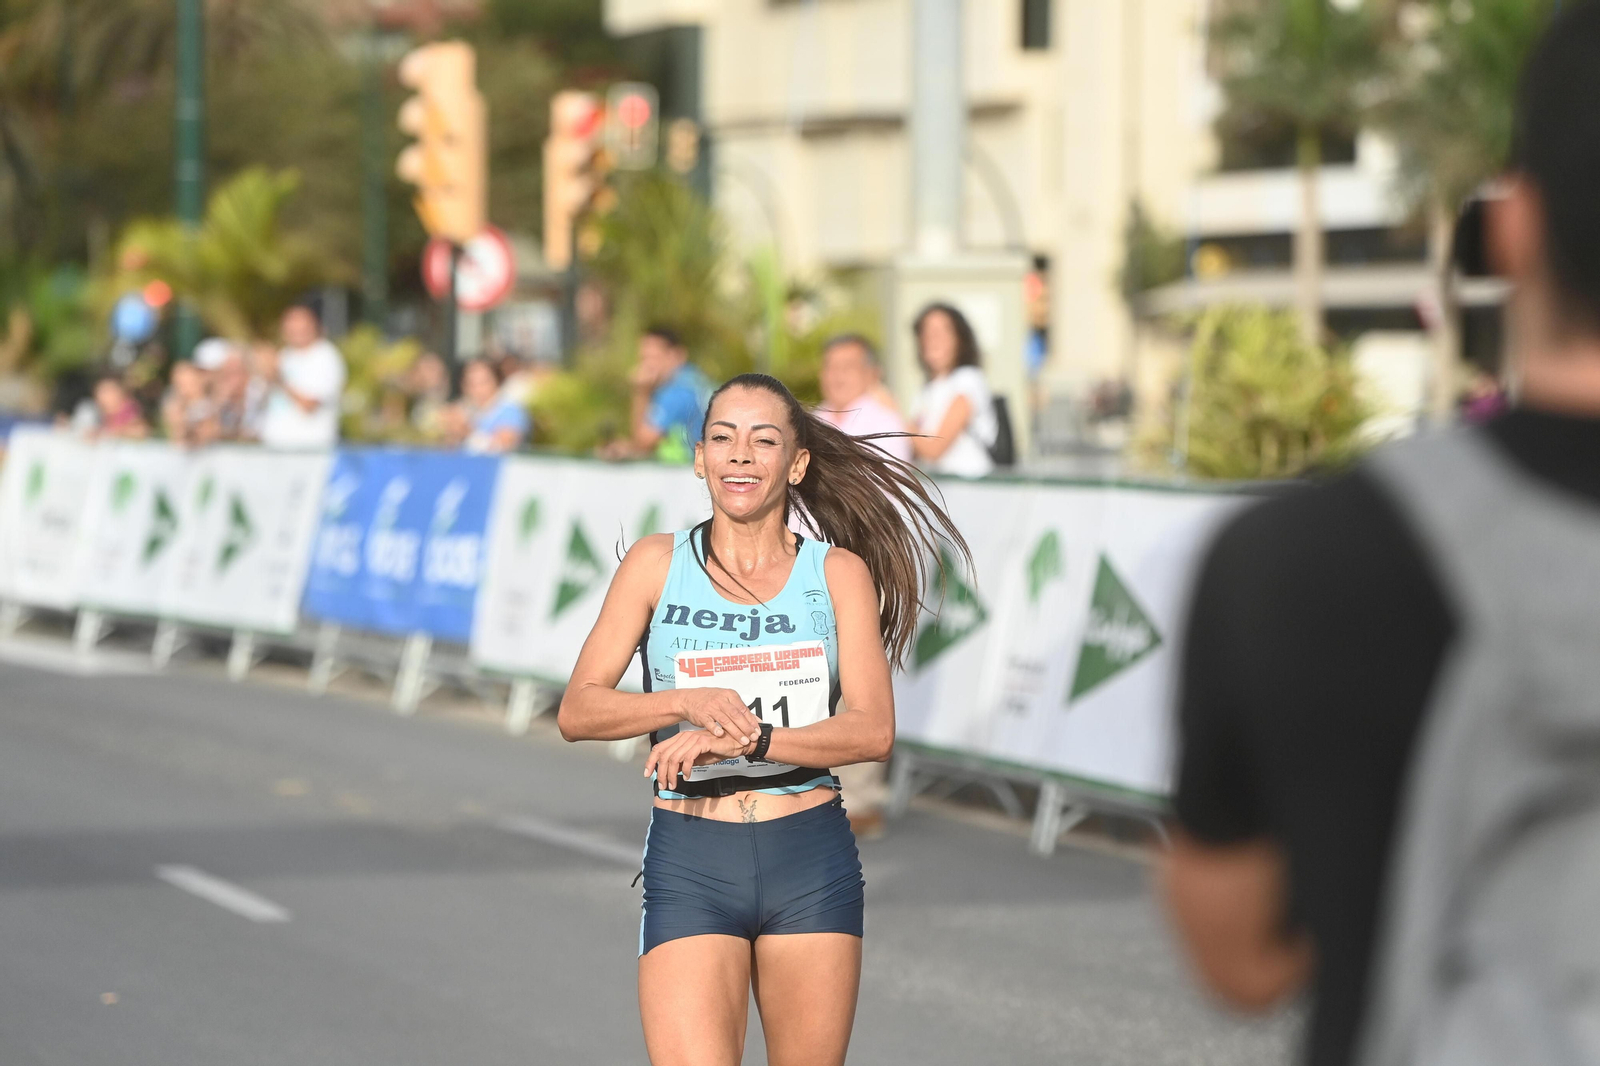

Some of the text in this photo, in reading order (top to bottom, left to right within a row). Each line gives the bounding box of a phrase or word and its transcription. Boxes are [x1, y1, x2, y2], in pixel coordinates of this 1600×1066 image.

[661, 603, 796, 641] nerja
[670, 636, 762, 650] ATLETI
[678, 647, 824, 678] 42 CARRERA URBANA
[714, 664, 743, 672] CIUDAD
[750, 659, 800, 673] MALAGA
[778, 676, 821, 687] FEDERADO
